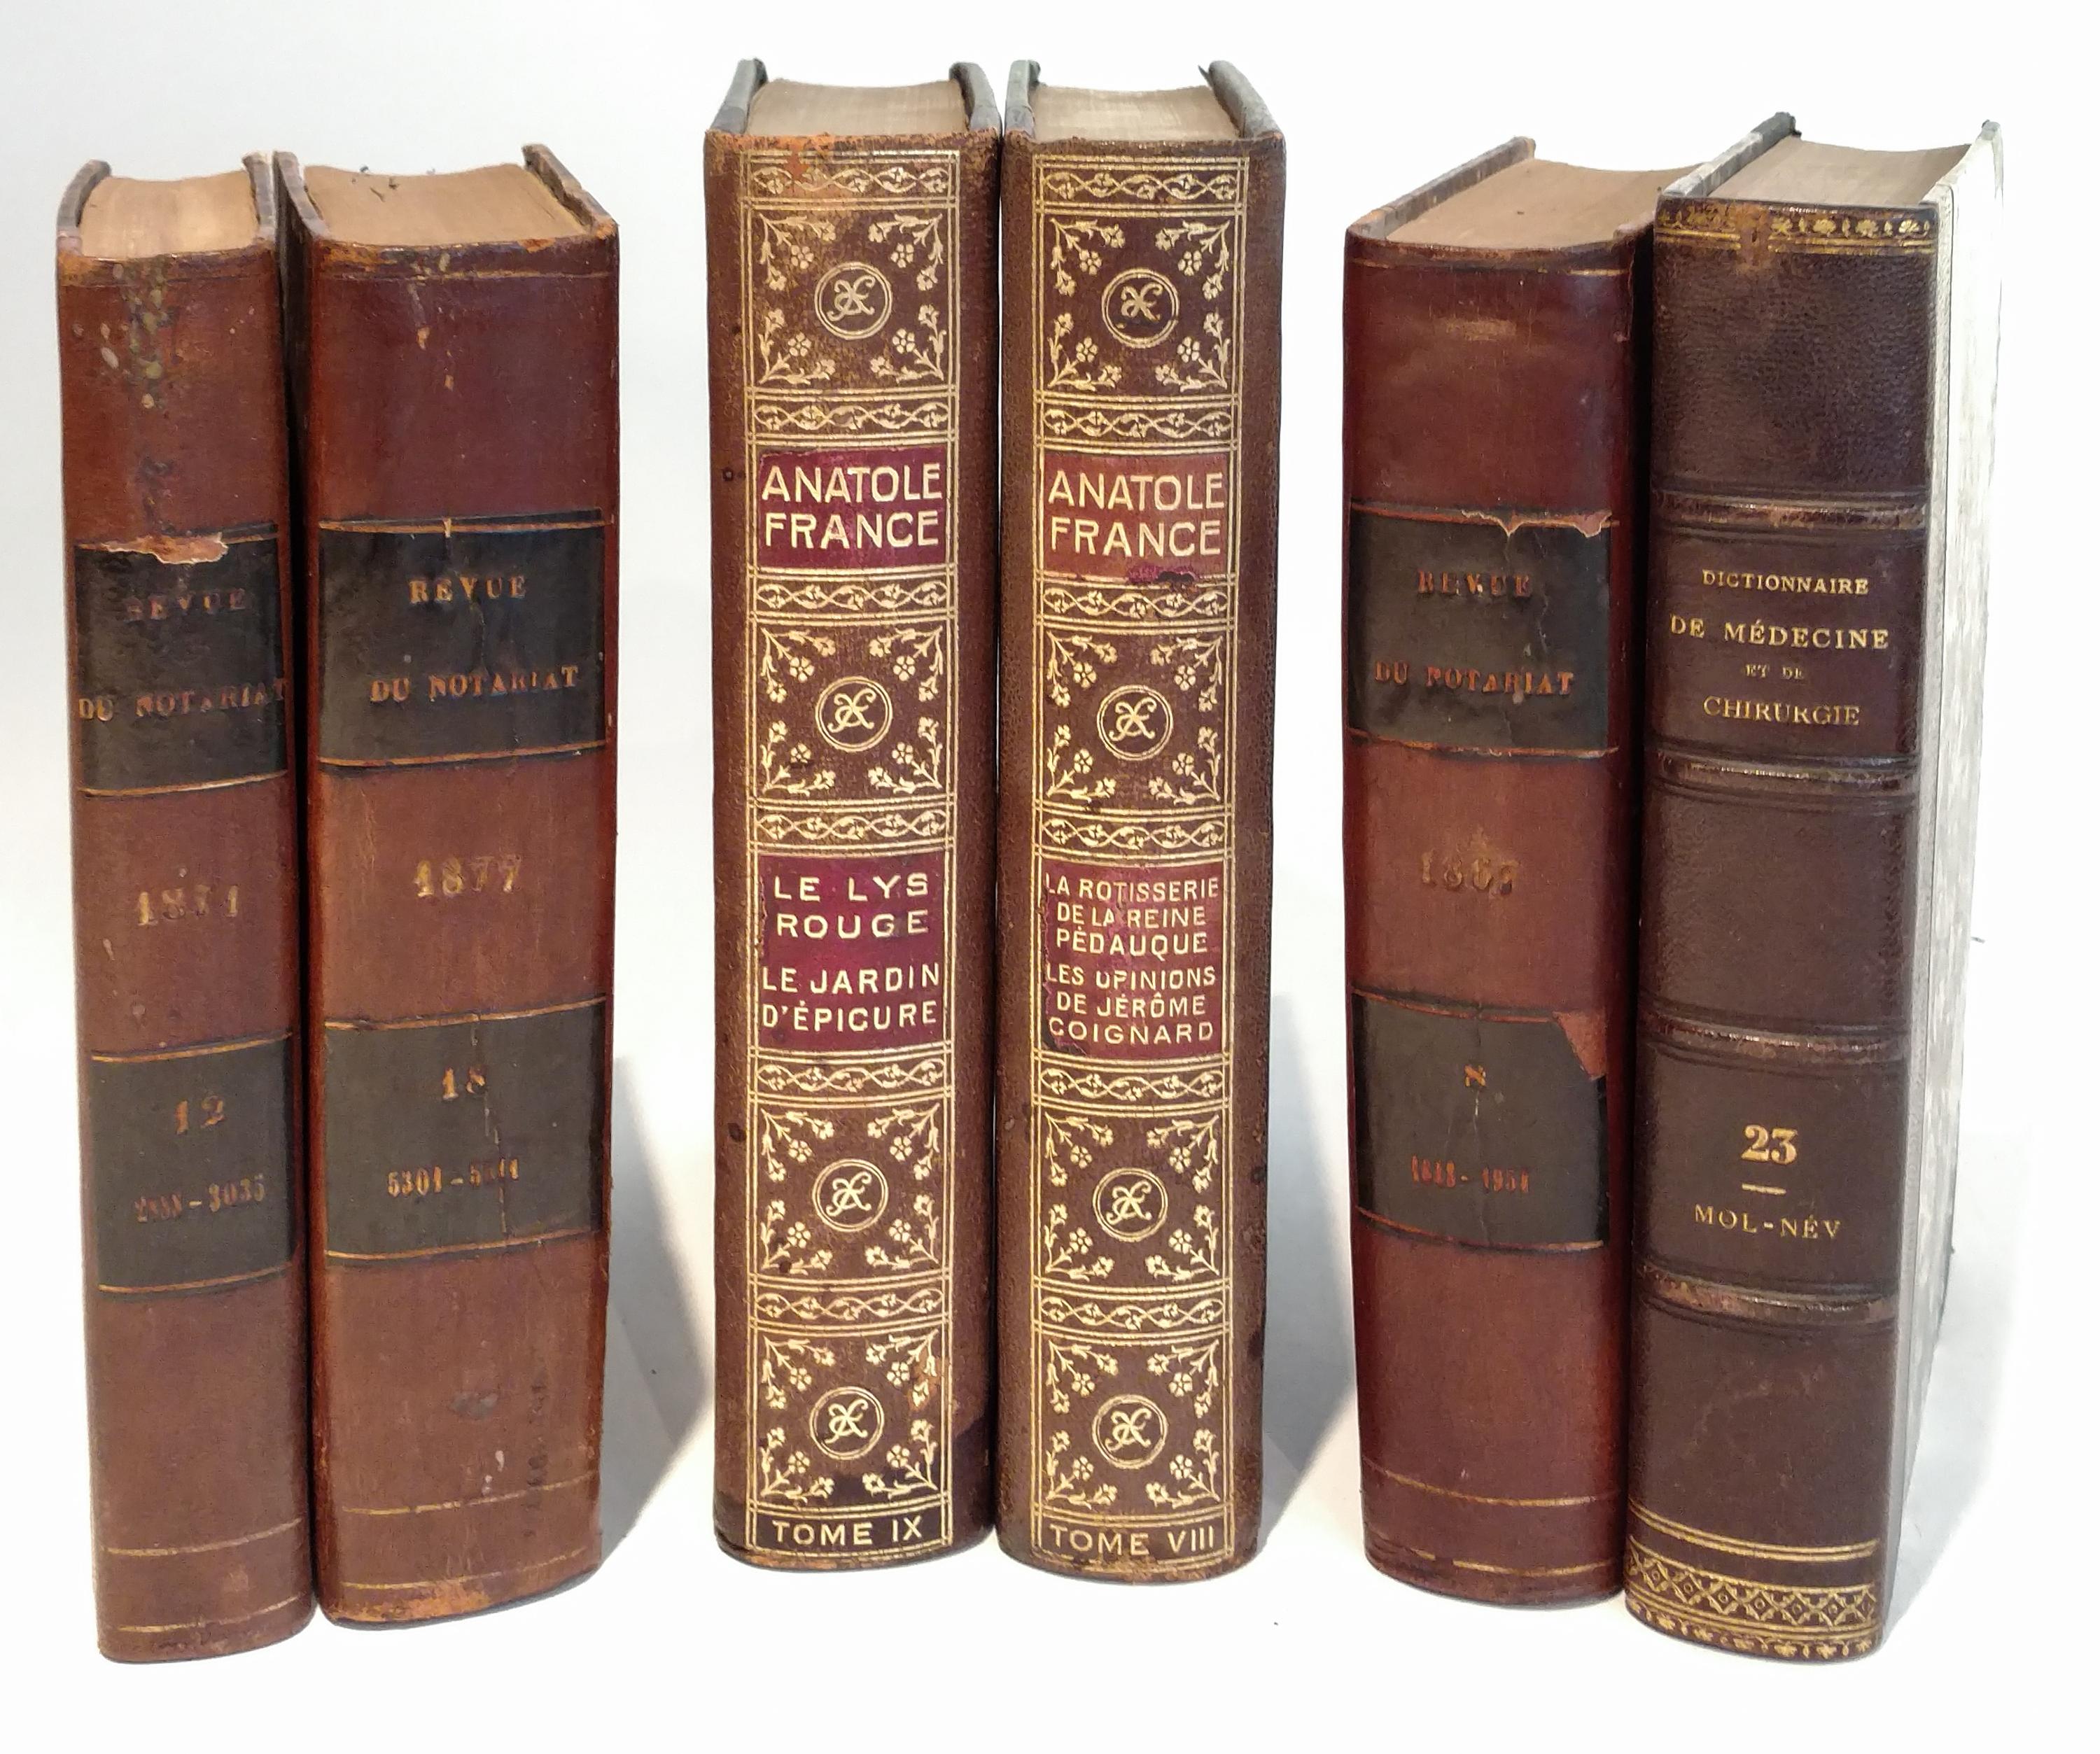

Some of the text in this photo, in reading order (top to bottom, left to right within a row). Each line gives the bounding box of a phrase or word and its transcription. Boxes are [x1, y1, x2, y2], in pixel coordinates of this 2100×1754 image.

[761, 463, 943, 503] ANATOLE
[1048, 470, 1226, 511] ANATOLE
[764, 511, 940, 549] FRANCE
[1050, 517, 1222, 557] FRANCE
[408, 575, 527, 605] REVUE
[1702, 568, 1870, 596] DICTIONNAIRE
[1670, 613, 1890, 650] DE MÉDECINE
[370, 664, 579, 703] DU NOTARIAT
[1374, 660, 1410, 687] DU
[1744, 664, 1771, 680] ET
[78, 696, 114, 722] DU
[1702, 695, 1862, 727] CHIRURGIE
[773, 871, 930, 904] LE LYS
[1045, 873, 1219, 903] LA ROTISSERIE
[776, 908, 930, 940] ROUGE
[1057, 901, 1208, 929] DE LA REINE
[1056, 925, 1208, 962] PÉDAUQUE
[762, 962, 941, 995] LE JARDIN
[1046, 962, 1085, 986] LES
[762, 999, 938, 1034] D'ÉPICURE
[1056, 990, 1207, 1018] DE JÉRÔME
[1049, 1017, 1214, 1046] COIGNARD
[1740, 1123, 1799, 1165] 23
[1693, 1203, 1842, 1240] MOL-NÉV
[772, 1515, 923, 1547] TOME IX
[1050, 1524, 1215, 1556] TOME VIII
